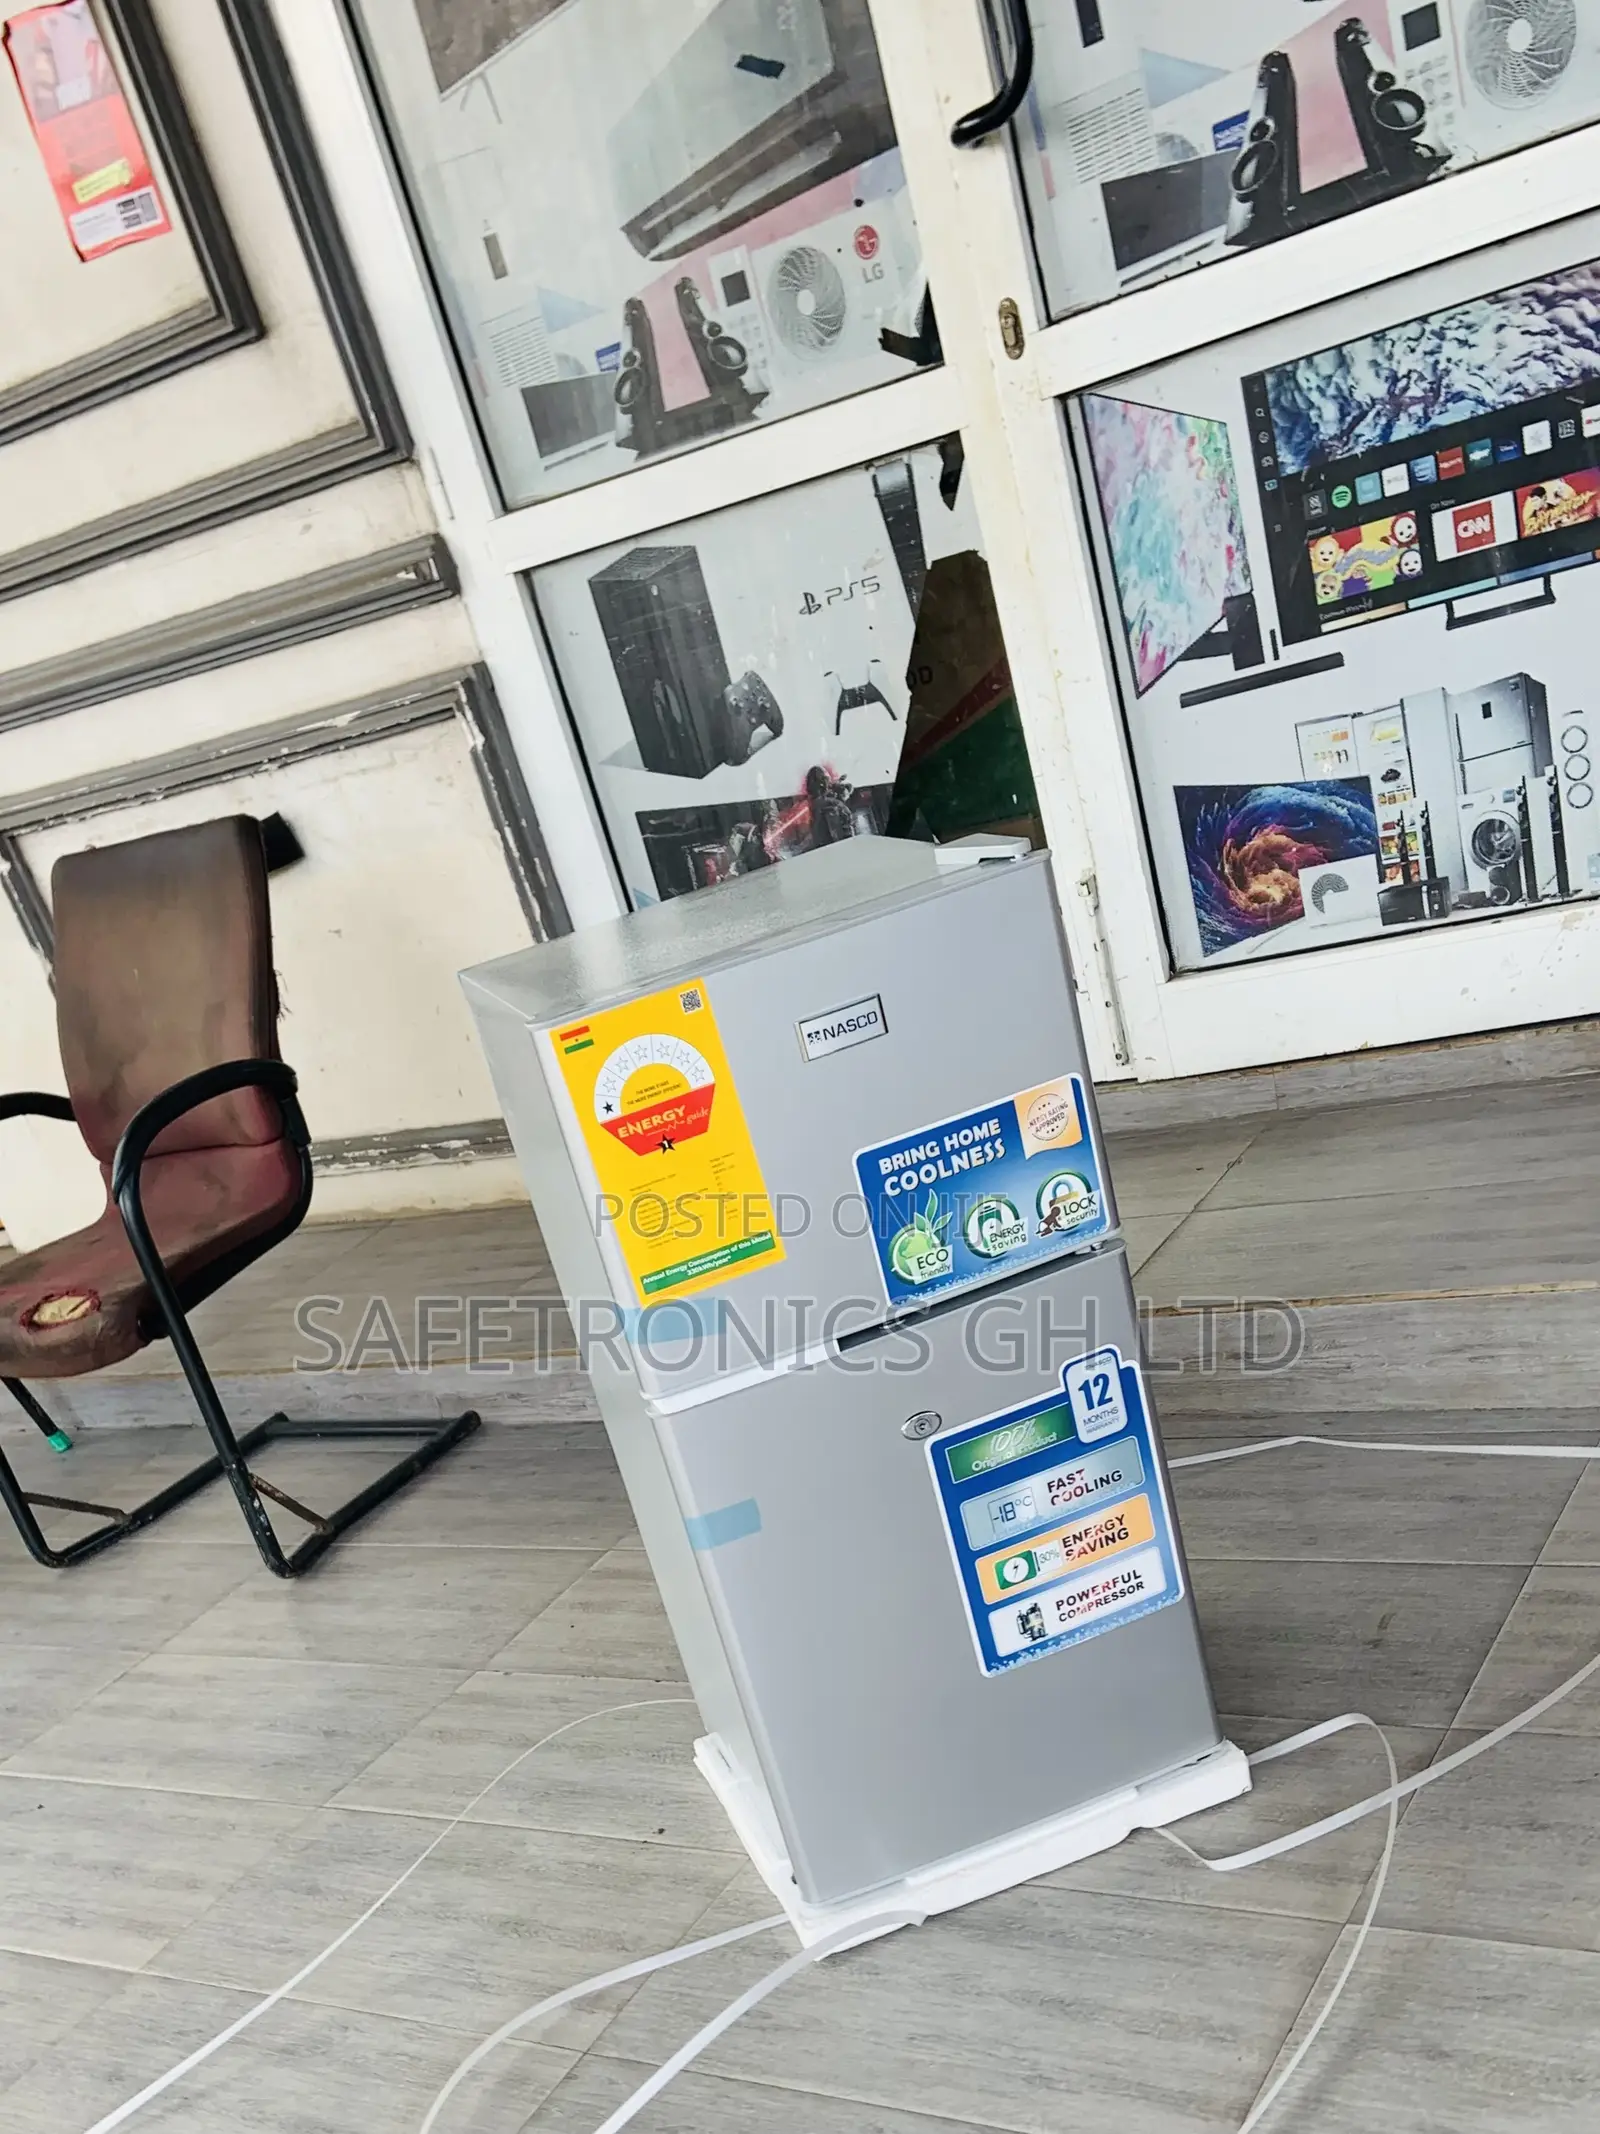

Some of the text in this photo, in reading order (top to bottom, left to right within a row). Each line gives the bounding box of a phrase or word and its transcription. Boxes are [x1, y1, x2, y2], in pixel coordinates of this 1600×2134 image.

[862, 263, 884, 284] LG
[1457, 514, 1491, 538] CNN
[825, 575, 880, 605] PS5
[822, 1010, 878, 1040] NASCO
[617, 1104, 686, 1139] ENERGY
[879, 1118, 1001, 1175] BRING HOME
[884, 1138, 1006, 1197] COOLNESS
[1063, 1195, 1096, 1216] LOCK
[1067, 1208, 1098, 1225] security
[989, 1221, 1025, 1243] ENERGY
[992, 1234, 1027, 1252] saving
[643, 1271, 665, 1284] Annual
[666, 1264, 688, 1277] Energy
[688, 1247, 731, 1268] Consumption
[730, 1244, 738, 1253] of
[917, 1249, 949, 1270] ECO
[920, 1264, 951, 1279] friendly
[1078, 1373, 1113, 1411] 12
[1083, 1407, 1119, 1427] MONTHS
[1086, 1417, 1120, 1434] WARRANTY
[1047, 1468, 1086, 1493] FAST
[1050, 1470, 1123, 1506] COOLING
[1062, 1514, 1125, 1549] ENERGY
[1065, 1527, 1129, 1561] SAVING
[1056, 1569, 1142, 1610] POWERFUL
[1058, 1581, 1145, 1622] COMPRESSOR
